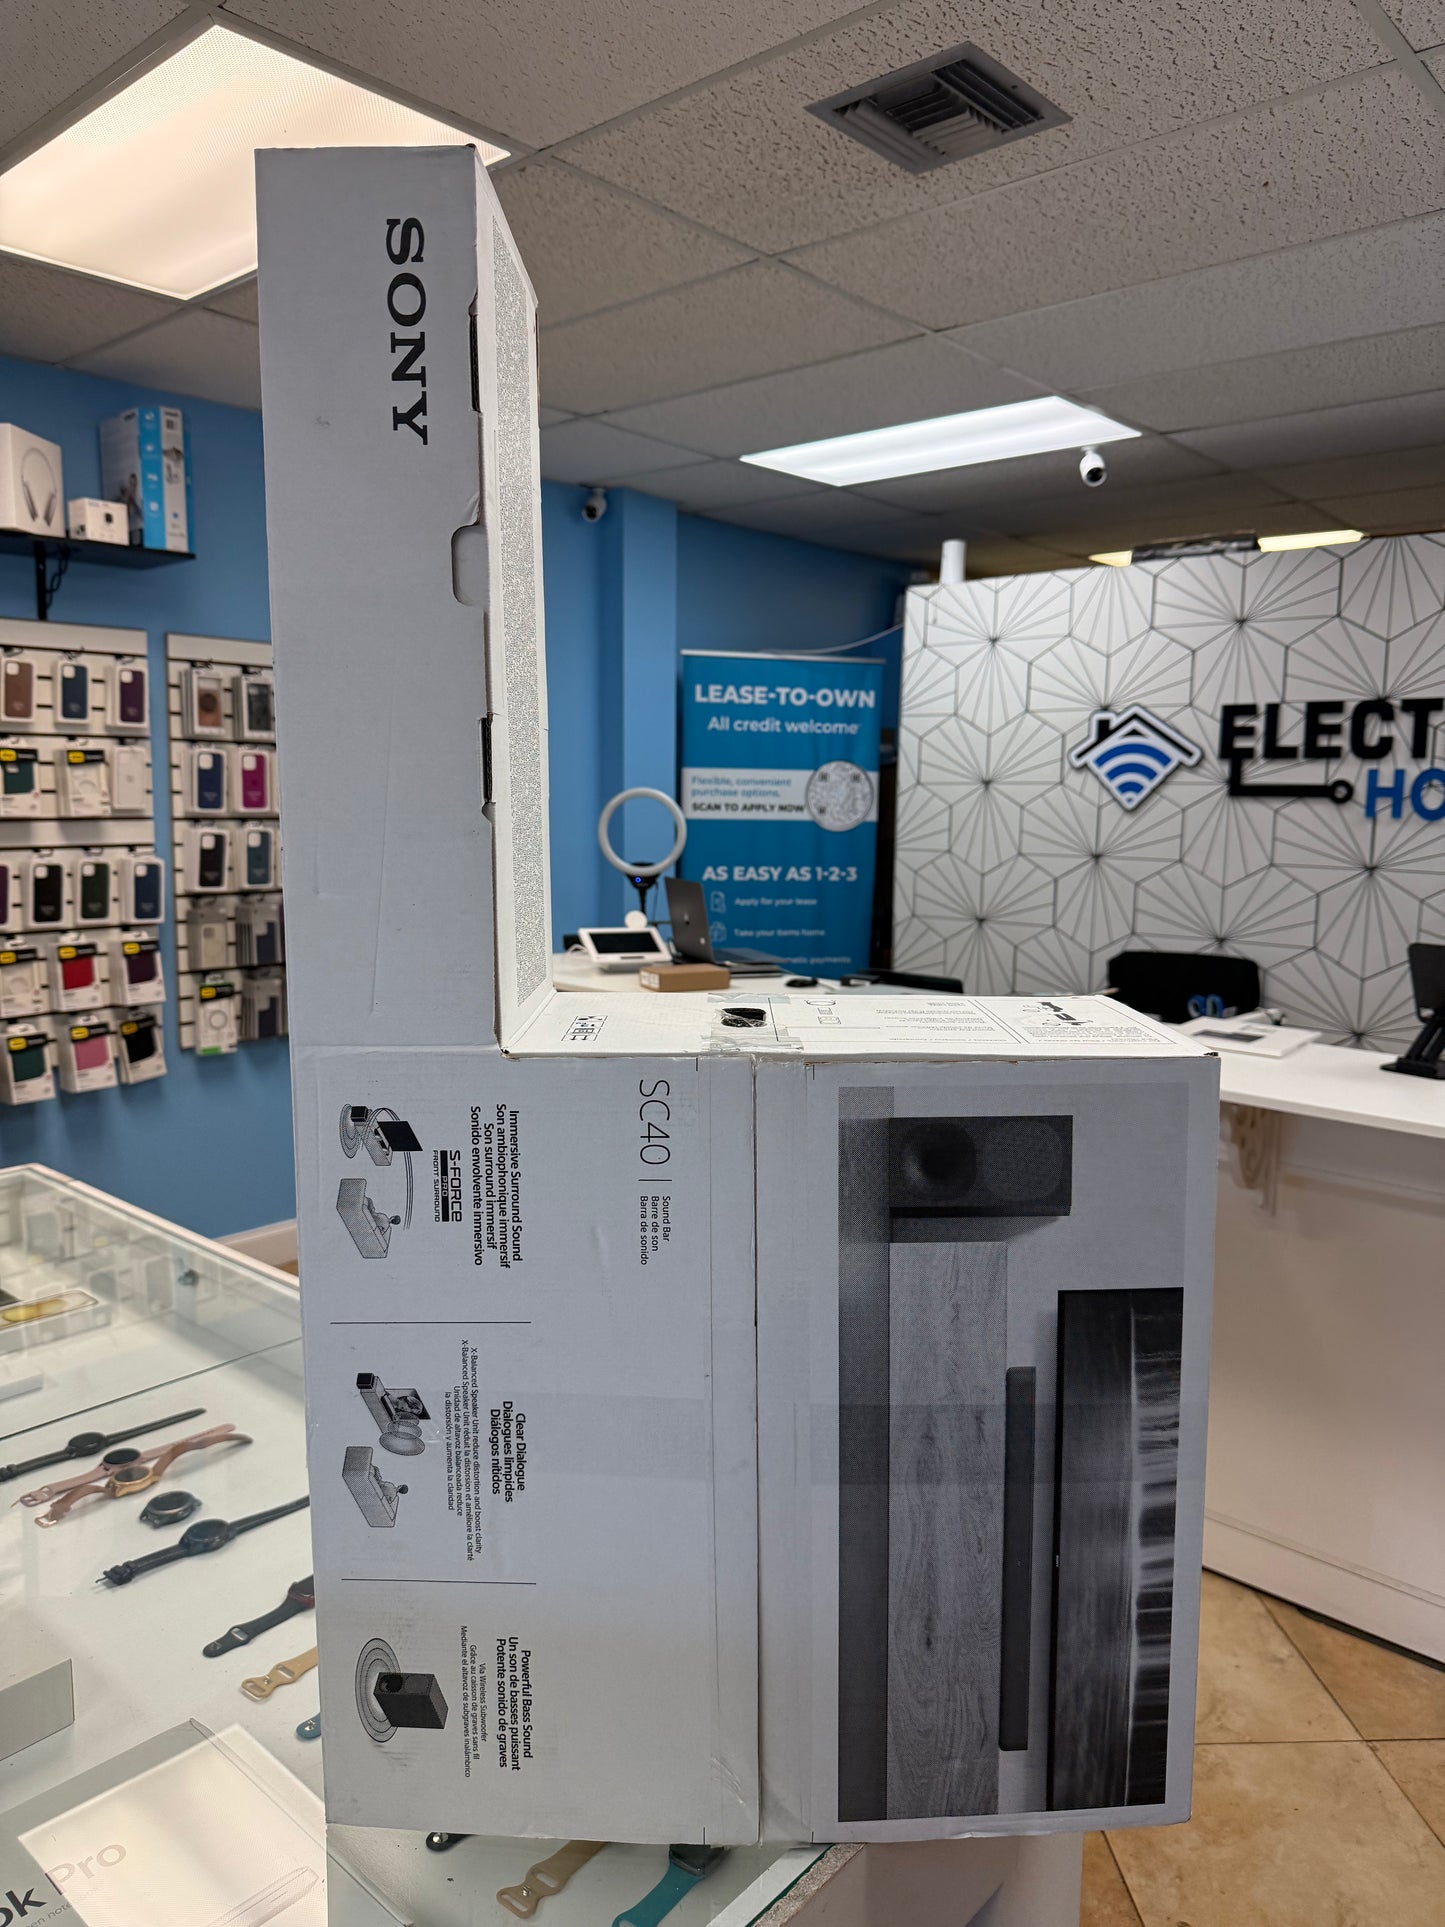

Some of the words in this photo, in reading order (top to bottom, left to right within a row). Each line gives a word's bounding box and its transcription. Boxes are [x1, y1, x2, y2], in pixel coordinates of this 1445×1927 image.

[385, 217, 429, 446] SONY
[695, 684, 875, 708] LEASE-TO-OWN
[707, 717, 730, 732] All
[733, 717, 781, 733] credit
[691, 776, 733, 786] Flexible,
[736, 777, 792, 787] convenient
[691, 788, 738, 798] purchase
[692, 803, 722, 812] SCAN
[725, 803, 739, 812] TO
[741, 803, 775, 813] APPLY
[778, 804, 805, 813] NOW
[703, 867, 727, 881] AS
[733, 867, 782, 881] EASY
[785, 867, 811, 881] AS
[816, 867, 857, 881] 1-2-3
[734, 897, 758, 907] Apply
[760, 897, 773, 906] for
[775, 898, 793, 907] your
[795, 897, 817, 906] lease
[734, 929, 753, 937] Take
[755, 930, 774, 938] your
[470, 1106, 482, 1145] Sonido
[497, 1104, 507, 1125] Son
[639, 1079, 671, 1165] SC40
[484, 1123, 494, 1144] Son
[509, 1110, 520, 1169] Immersive
[472, 1147, 483, 1209] envolvente
[485, 1147, 495, 1198] surround
[496, 1127, 508, 1216] ambiophonique
[511, 1172, 521, 1223] Surround
[640, 1196, 648, 1219] Barra
[651, 1196, 659, 1219] Barre
[662, 1196, 671, 1224] Sound
[474, 1211, 484, 1266] inmersivo
[486, 1200, 497, 1249] immersif
[640, 1221, 648, 1233] de
[651, 1222, 659, 1233] de
[662, 1227, 671, 1241] Bar
[499, 1219, 510, 1269] immersif
[512, 1225, 523, 1262] Sound
[640, 1235, 648, 1265] sonido
[461, 1340, 469, 1380] X-Balanced
[445, 1400, 453, 1434] distorsión
[455, 1413, 461, 1422] de
[502, 1401, 514, 1455] Dialogues
[516, 1413, 525, 1441] Clear
[463, 1427, 471, 1448] réduit
[489, 1409, 501, 1456] Diálogos
[464, 1458, 472, 1492] distorsion
[491, 1458, 502, 1494] nítidos
[503, 1457, 514, 1502] limpides
[515, 1443, 526, 1491] Dialogue
[474, 1533, 482, 1553] clarity
[497, 1639, 506, 1678] Potente
[509, 1637, 518, 1651] Un
[470, 1666, 476, 1674] au
[509, 1653, 517, 1672] son
[521, 1650, 532, 1696] Powerful
[463, 1692, 469, 1701] de
[509, 1675, 519, 1688] de
[471, 1702, 478, 1711] de
[498, 1681, 507, 1716] sonido
[510, 1690, 520, 1724] basses
[522, 1699, 532, 1722] Bass
[462, 1703, 470, 1737] subgraves
[498, 1718, 508, 1731] de
[497, 1733, 507, 1767] graves
[509, 1727, 521, 1771] puissant
[523, 1725, 533, 1758] Sound
